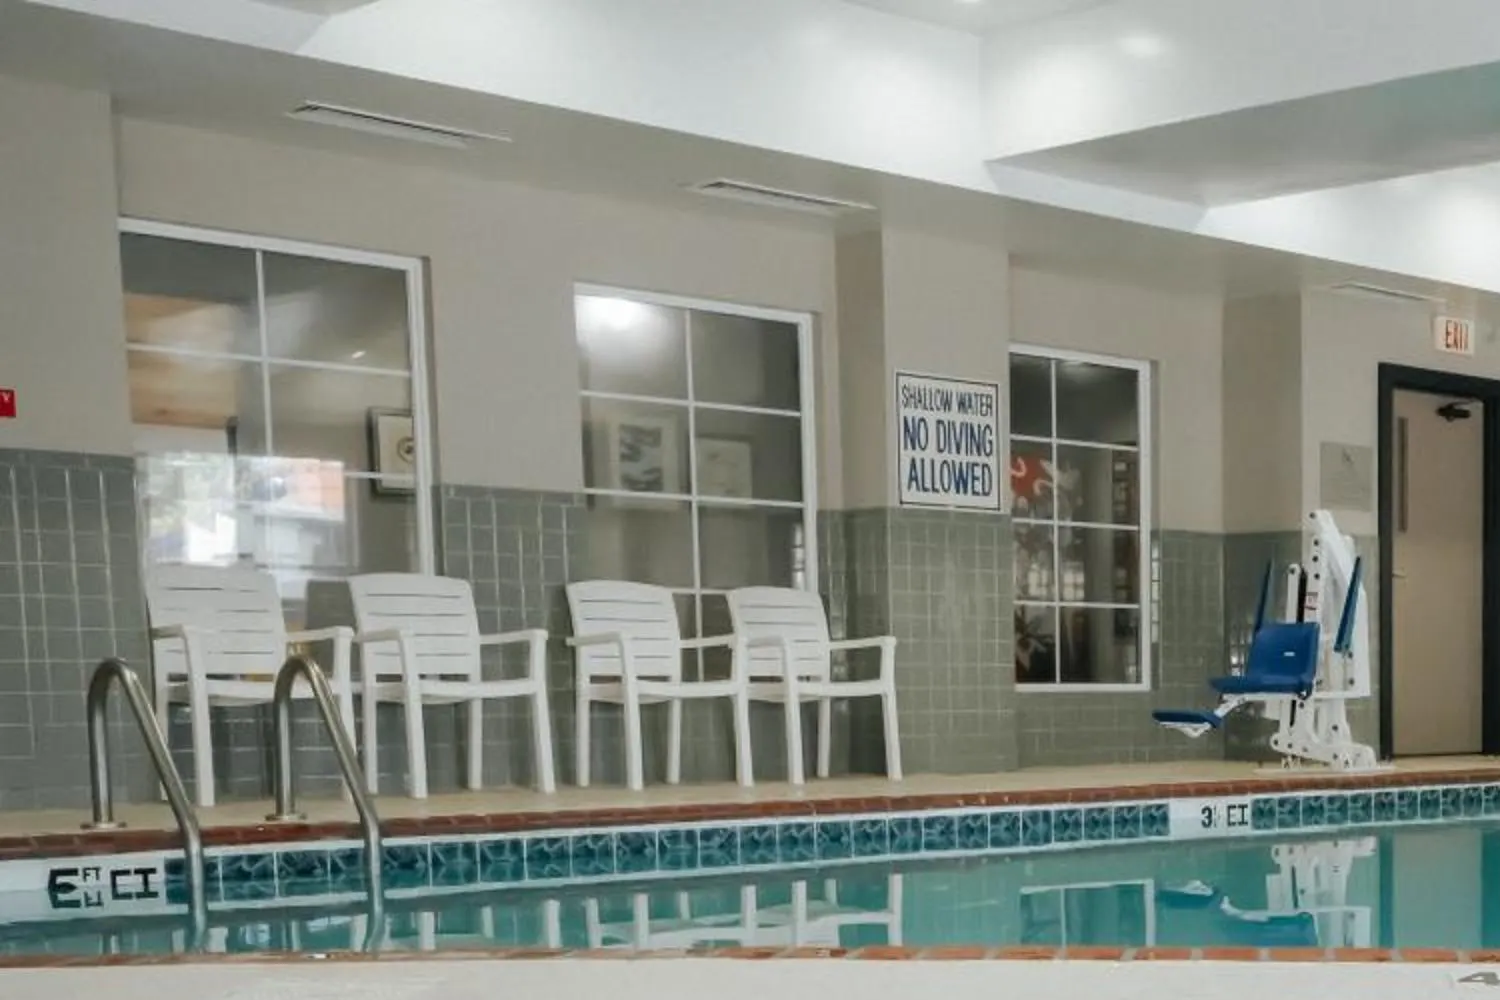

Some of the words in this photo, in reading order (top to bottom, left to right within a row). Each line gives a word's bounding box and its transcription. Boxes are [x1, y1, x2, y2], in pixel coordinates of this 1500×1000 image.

[901, 383, 953, 413] SHALLOW
[956, 391, 993, 417] WATER
[903, 415, 929, 451] NO
[936, 419, 993, 458] DIVING
[907, 457, 993, 497] ALLOWED
